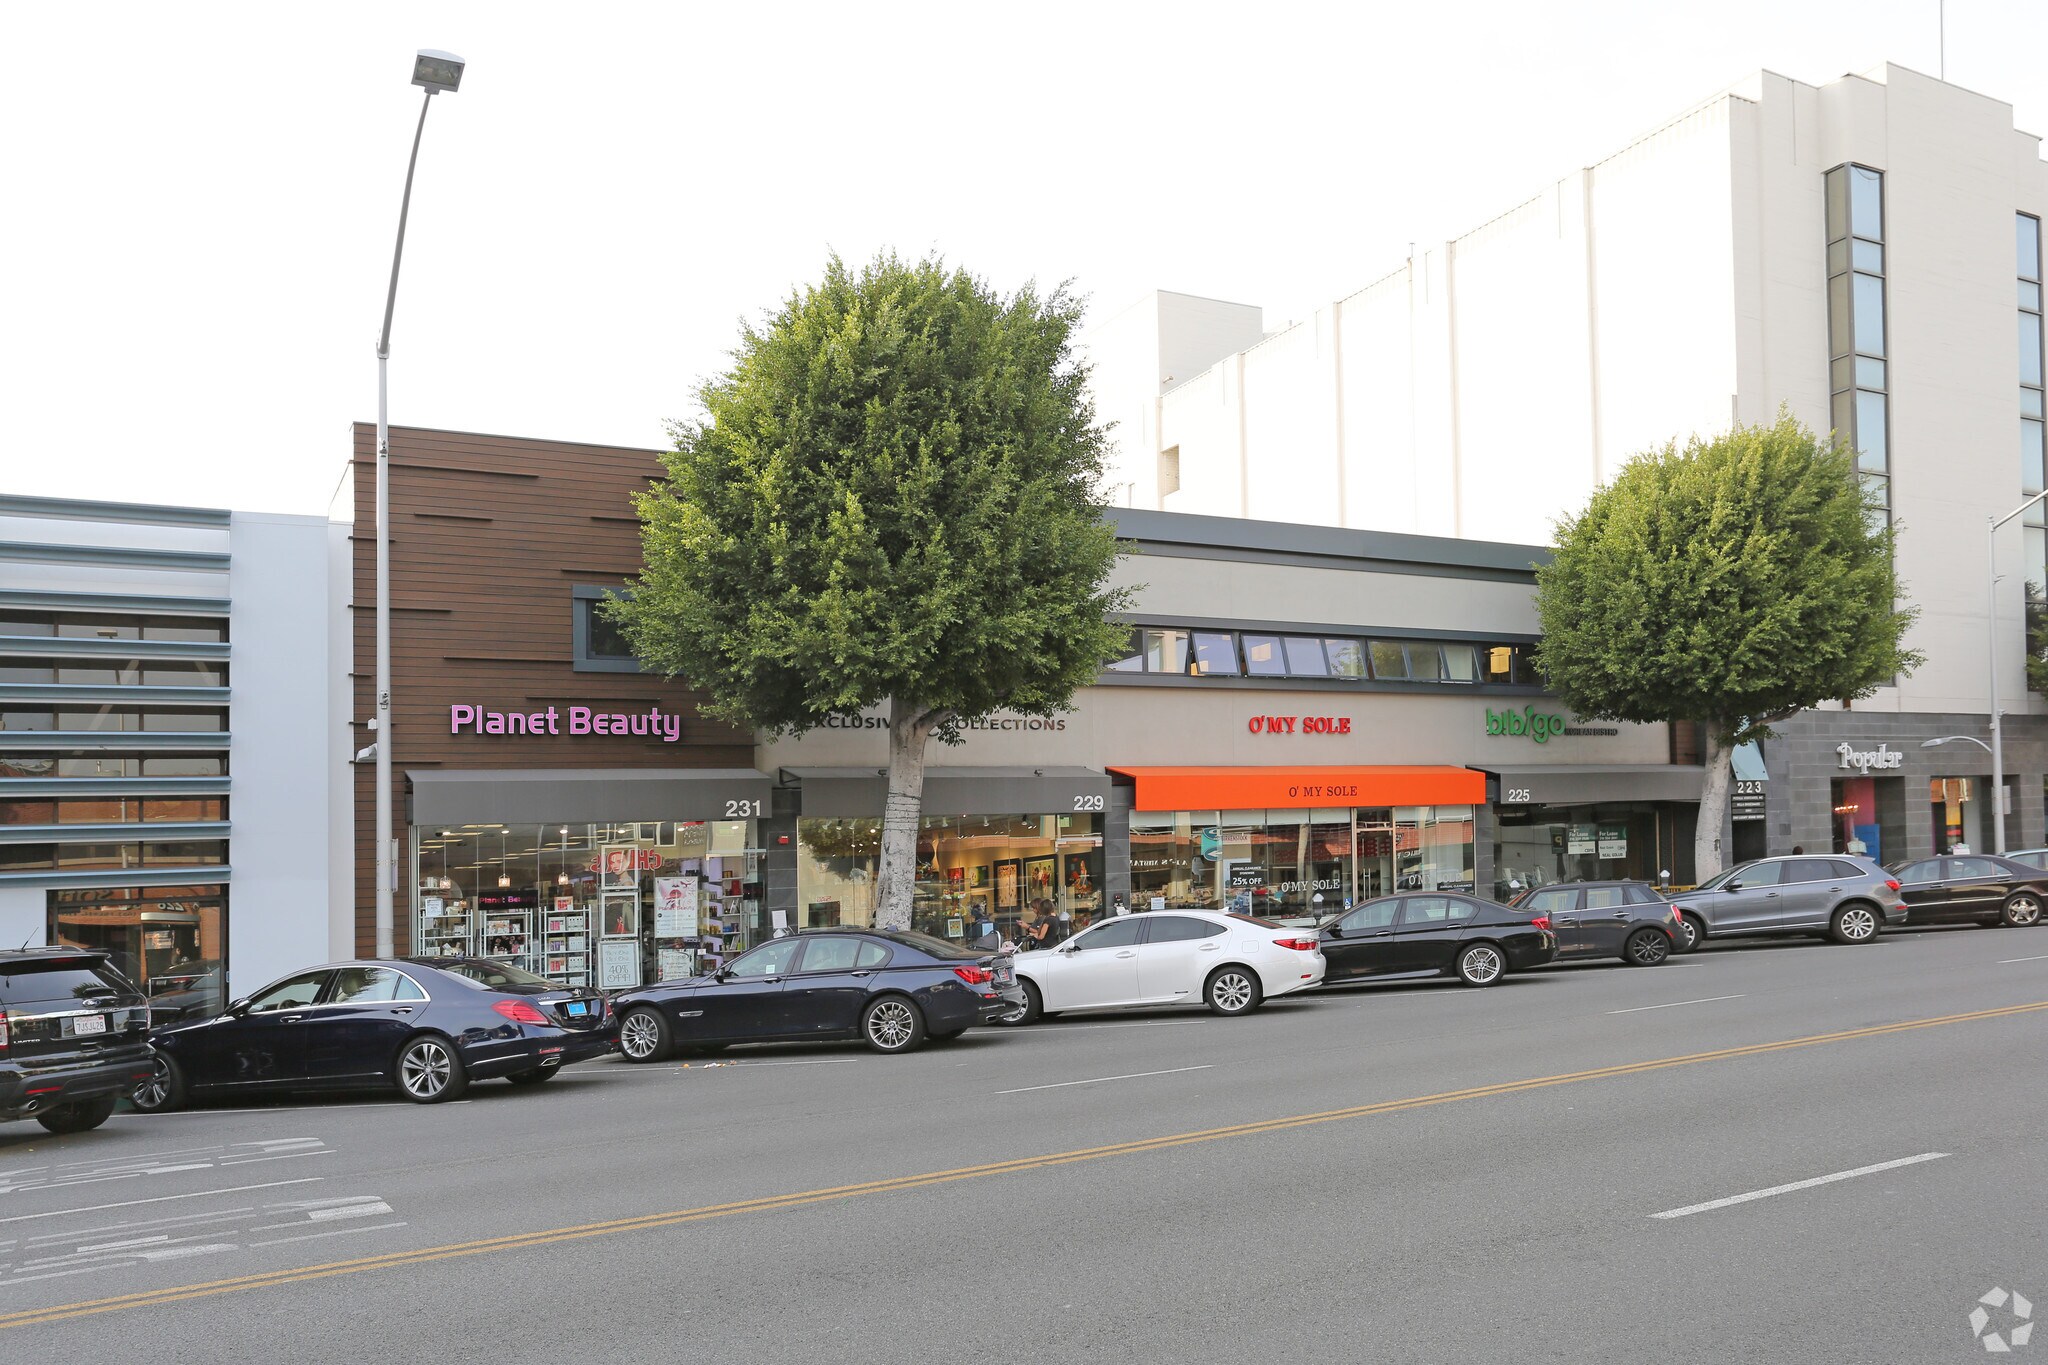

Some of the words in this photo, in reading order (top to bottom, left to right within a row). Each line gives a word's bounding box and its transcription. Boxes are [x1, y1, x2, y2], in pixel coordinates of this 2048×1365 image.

[451, 705, 558, 735] Planet
[569, 706, 680, 742] Beauty
[806, 716, 890, 729] XCLUSIV
[953, 718, 1066, 731] OLLECTIONS
[1249, 715, 1298, 734] O'MY
[1303, 716, 1351, 734] SOLE
[1486, 705, 1566, 743] bibigo
[1836, 742, 1903, 774] Popular
[1303, 786, 1323, 797] MY
[1326, 785, 1358, 797] SOLE
[1737, 781, 1761, 793] 223
[1073, 795, 1104, 811] 229
[1508, 789, 1530, 802] 225
[725, 800, 762, 817] 231
[1232, 877, 1248, 886] 25%
[1249, 877, 1262, 885] OFF
[1281, 880, 1308, 893] O'MY
[1312, 878, 1340, 891] SOLE
